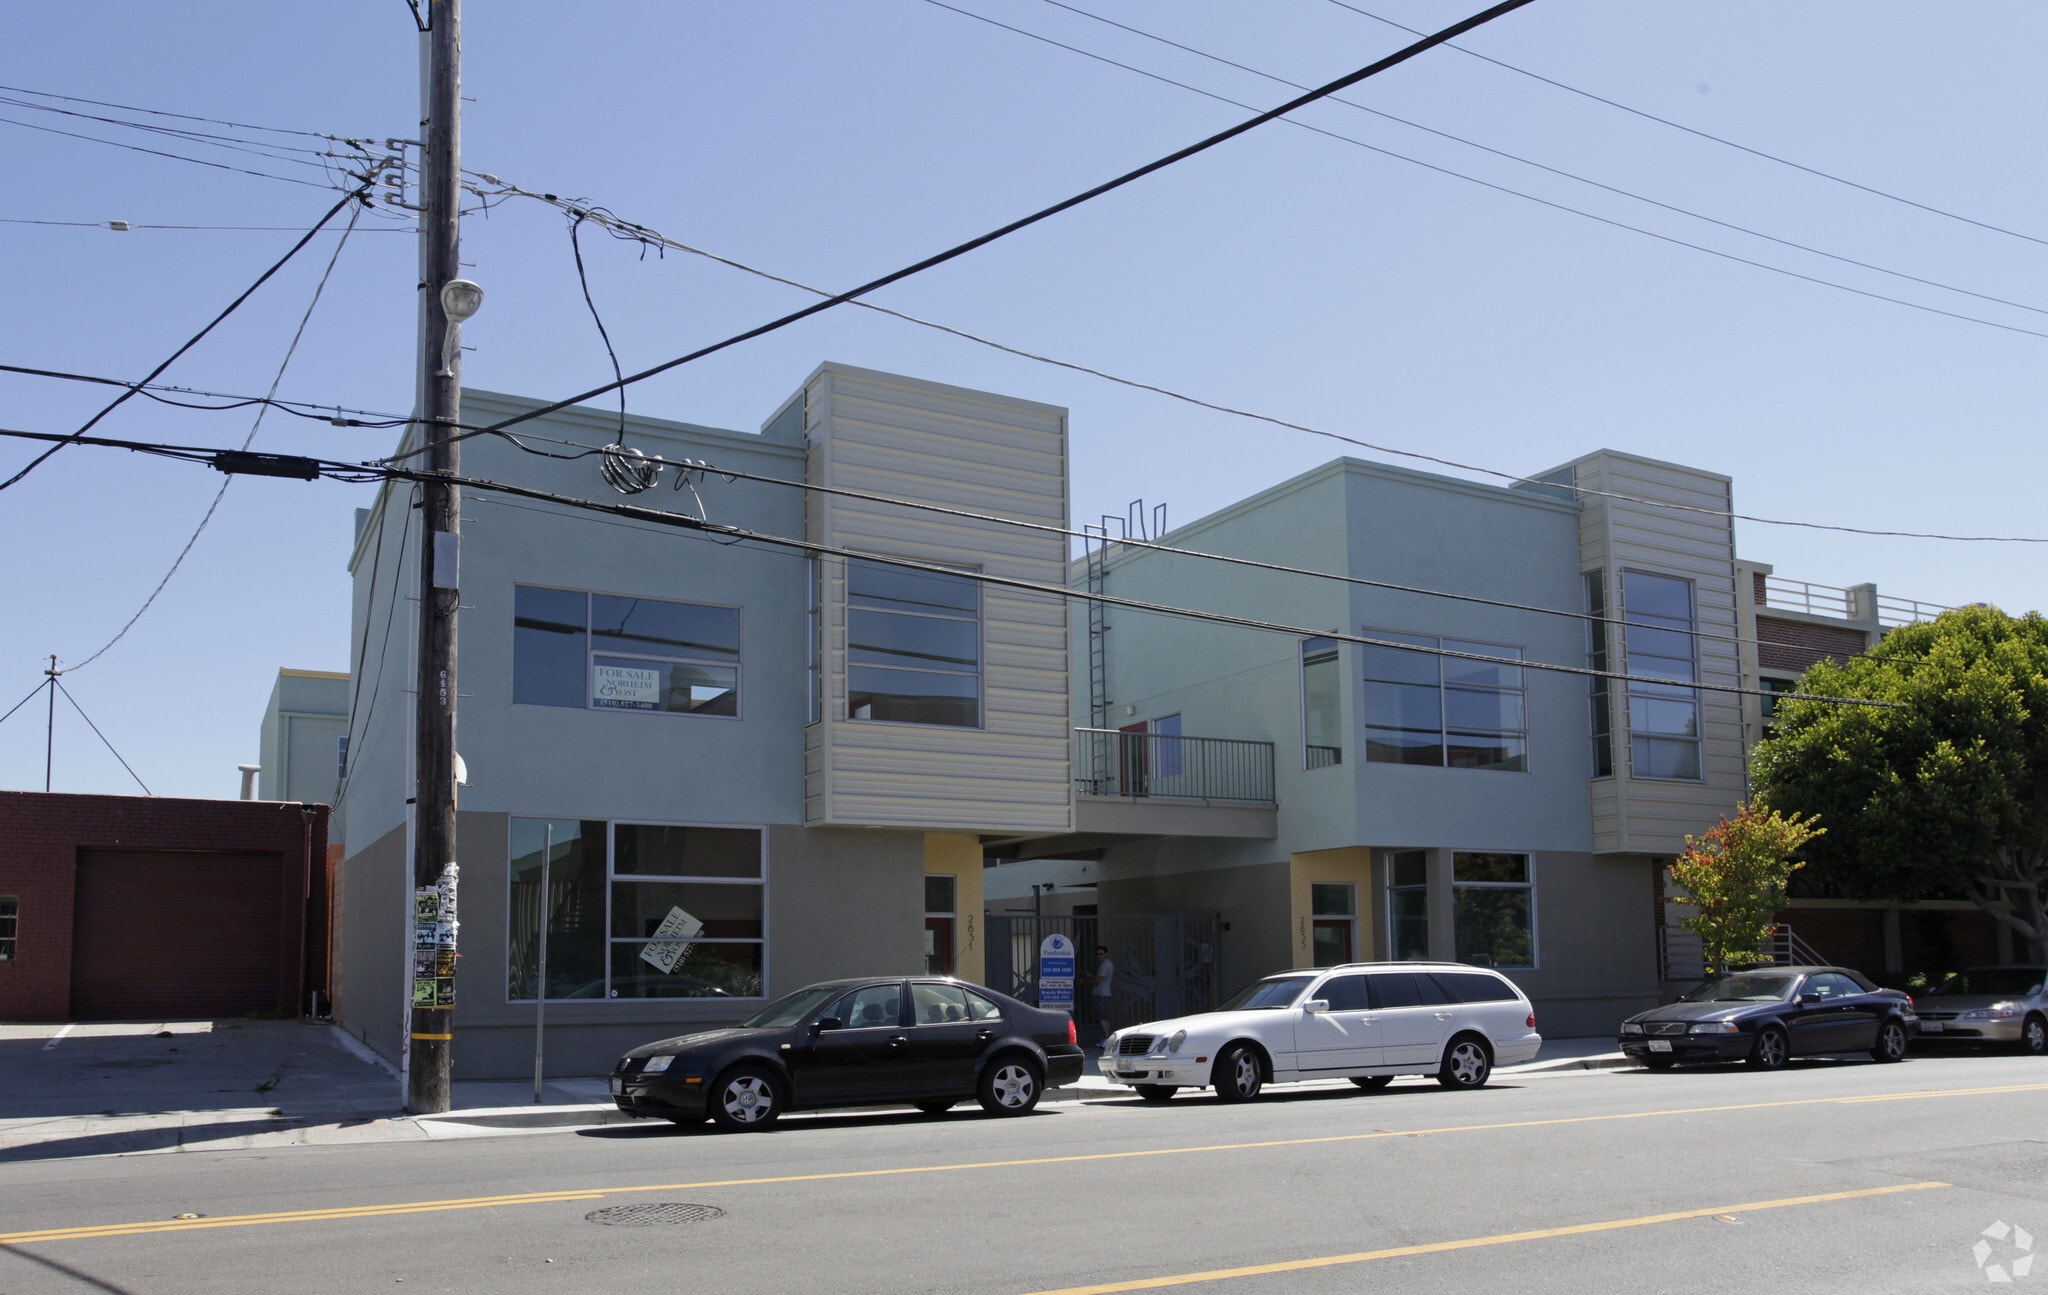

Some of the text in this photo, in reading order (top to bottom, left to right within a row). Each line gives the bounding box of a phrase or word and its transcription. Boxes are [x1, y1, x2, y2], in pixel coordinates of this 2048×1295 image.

[600, 668, 655, 680] FOR SALE
[606, 679, 652, 689] NORHEIM
[615, 688, 638, 697] YOST
[600, 699, 653, 709] (510) 527-3400
[660, 912, 680, 936] SALE
[967, 914, 975, 951] 2831
[673, 930, 705, 973] (510) 527-00
